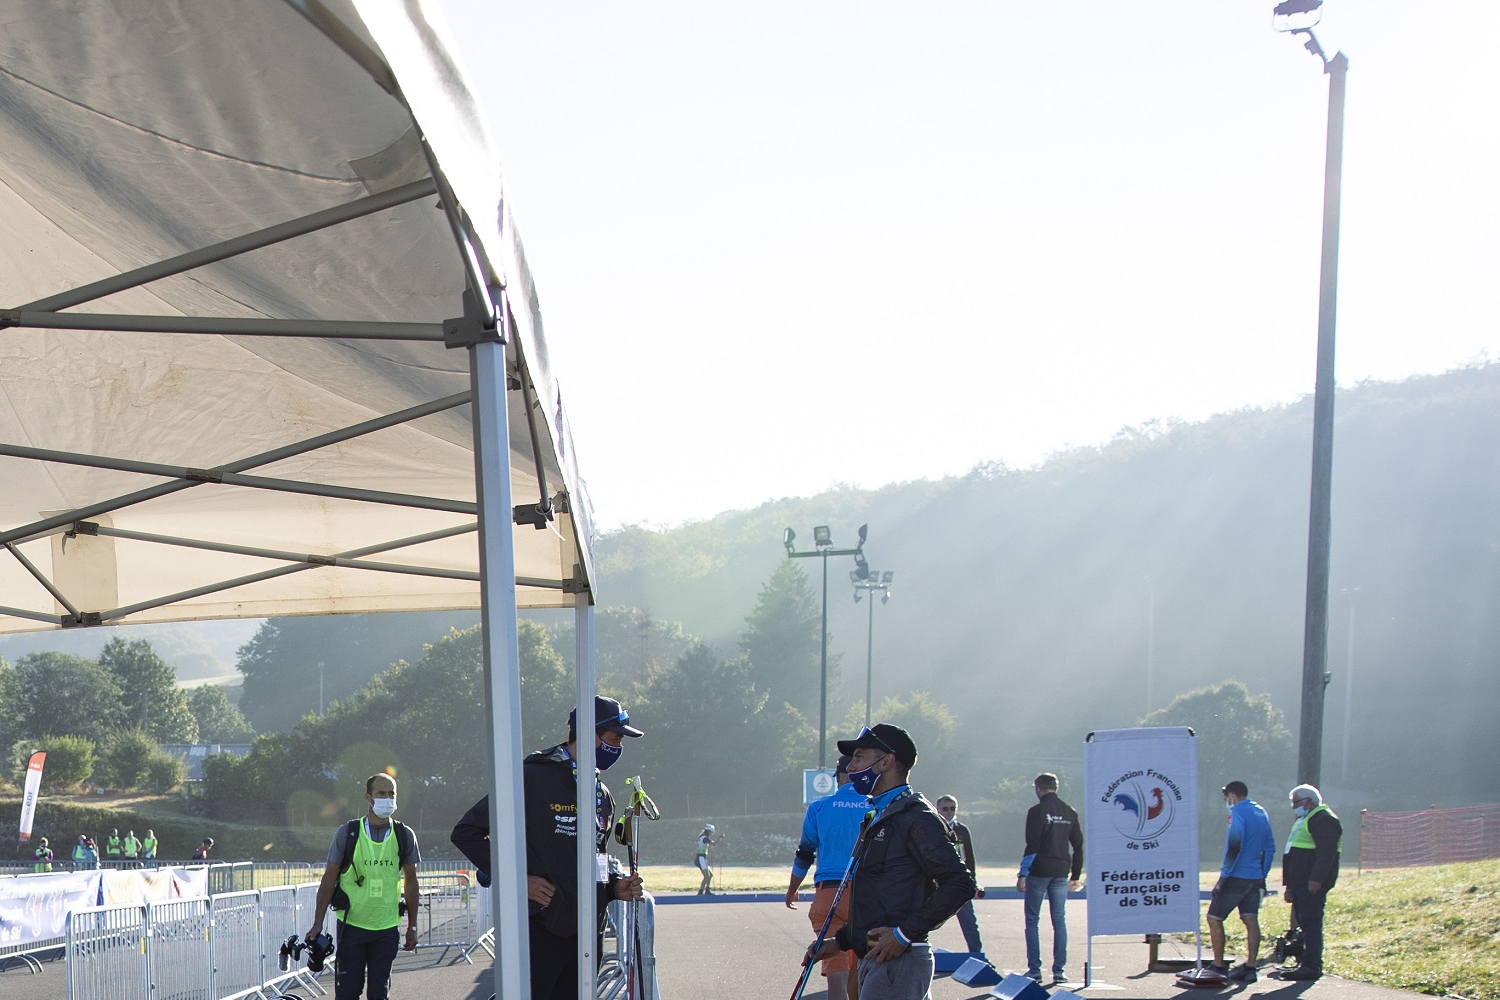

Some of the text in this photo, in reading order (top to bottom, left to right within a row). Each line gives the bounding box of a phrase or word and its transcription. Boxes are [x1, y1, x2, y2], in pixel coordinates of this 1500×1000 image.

[1101, 769, 1182, 803] Fédération Française
[1127, 840, 1159, 850] de Ski
[1101, 869, 1184, 882] Fédération
[1105, 882, 1181, 896] Française
[1119, 895, 1168, 907] de Ski
